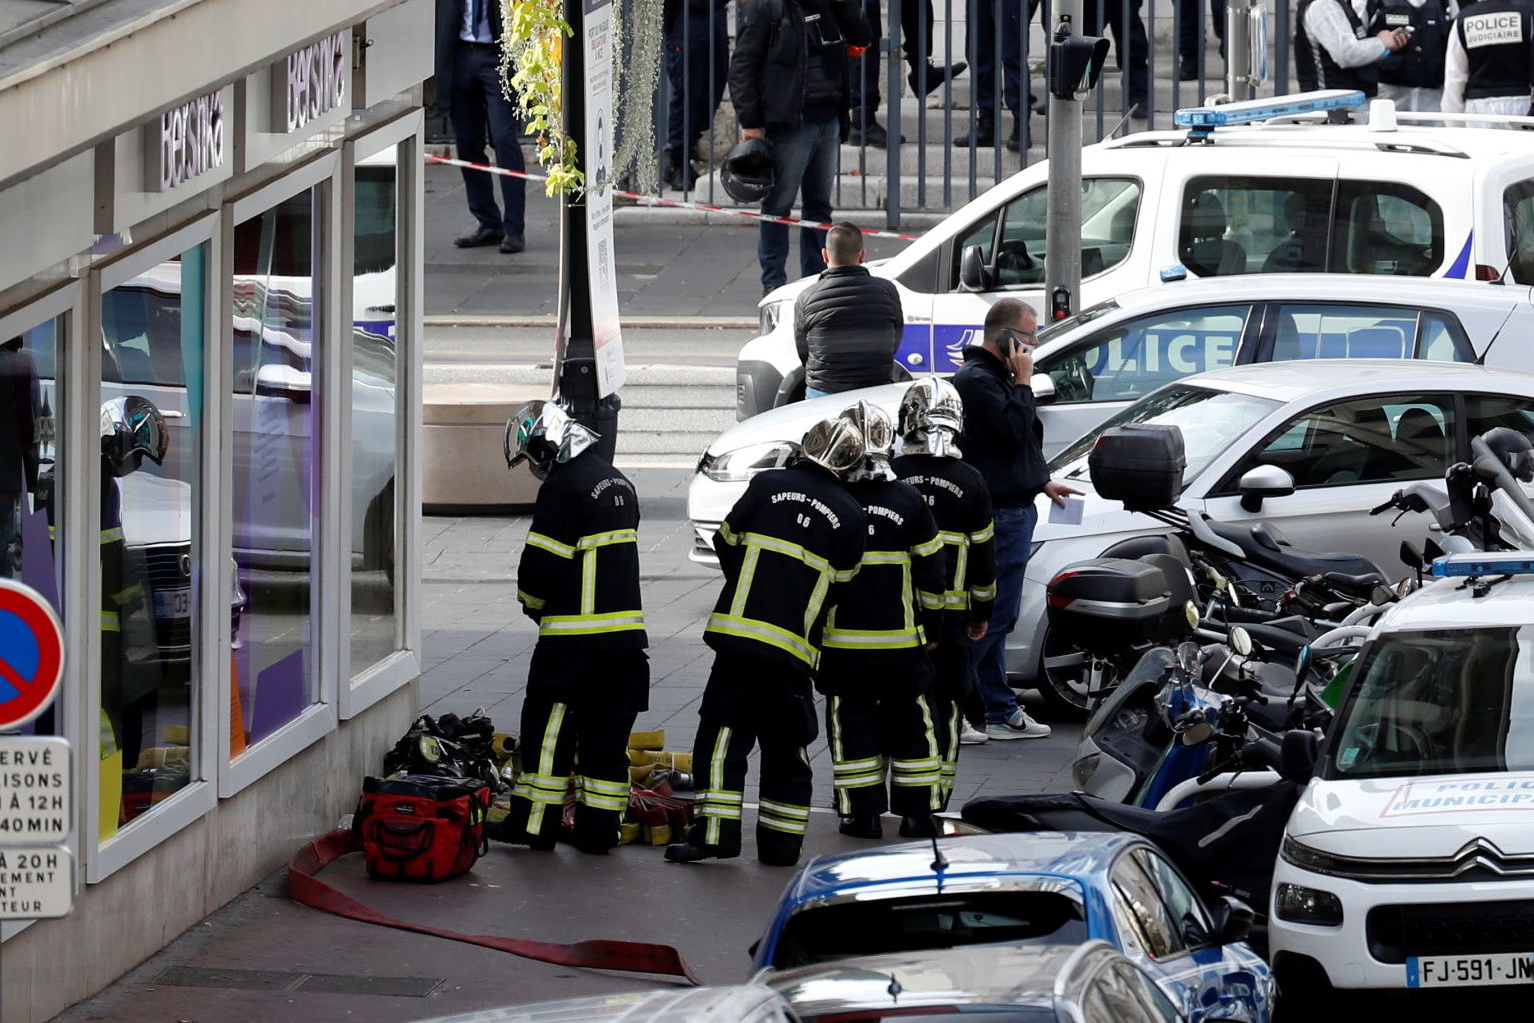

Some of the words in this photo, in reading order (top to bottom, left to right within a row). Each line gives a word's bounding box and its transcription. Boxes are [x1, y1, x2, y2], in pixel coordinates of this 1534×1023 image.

[1466, 16, 1519, 33] POLICE
[1469, 30, 1520, 44] JUDICIAIRE
[796, 513, 811, 528] 06
